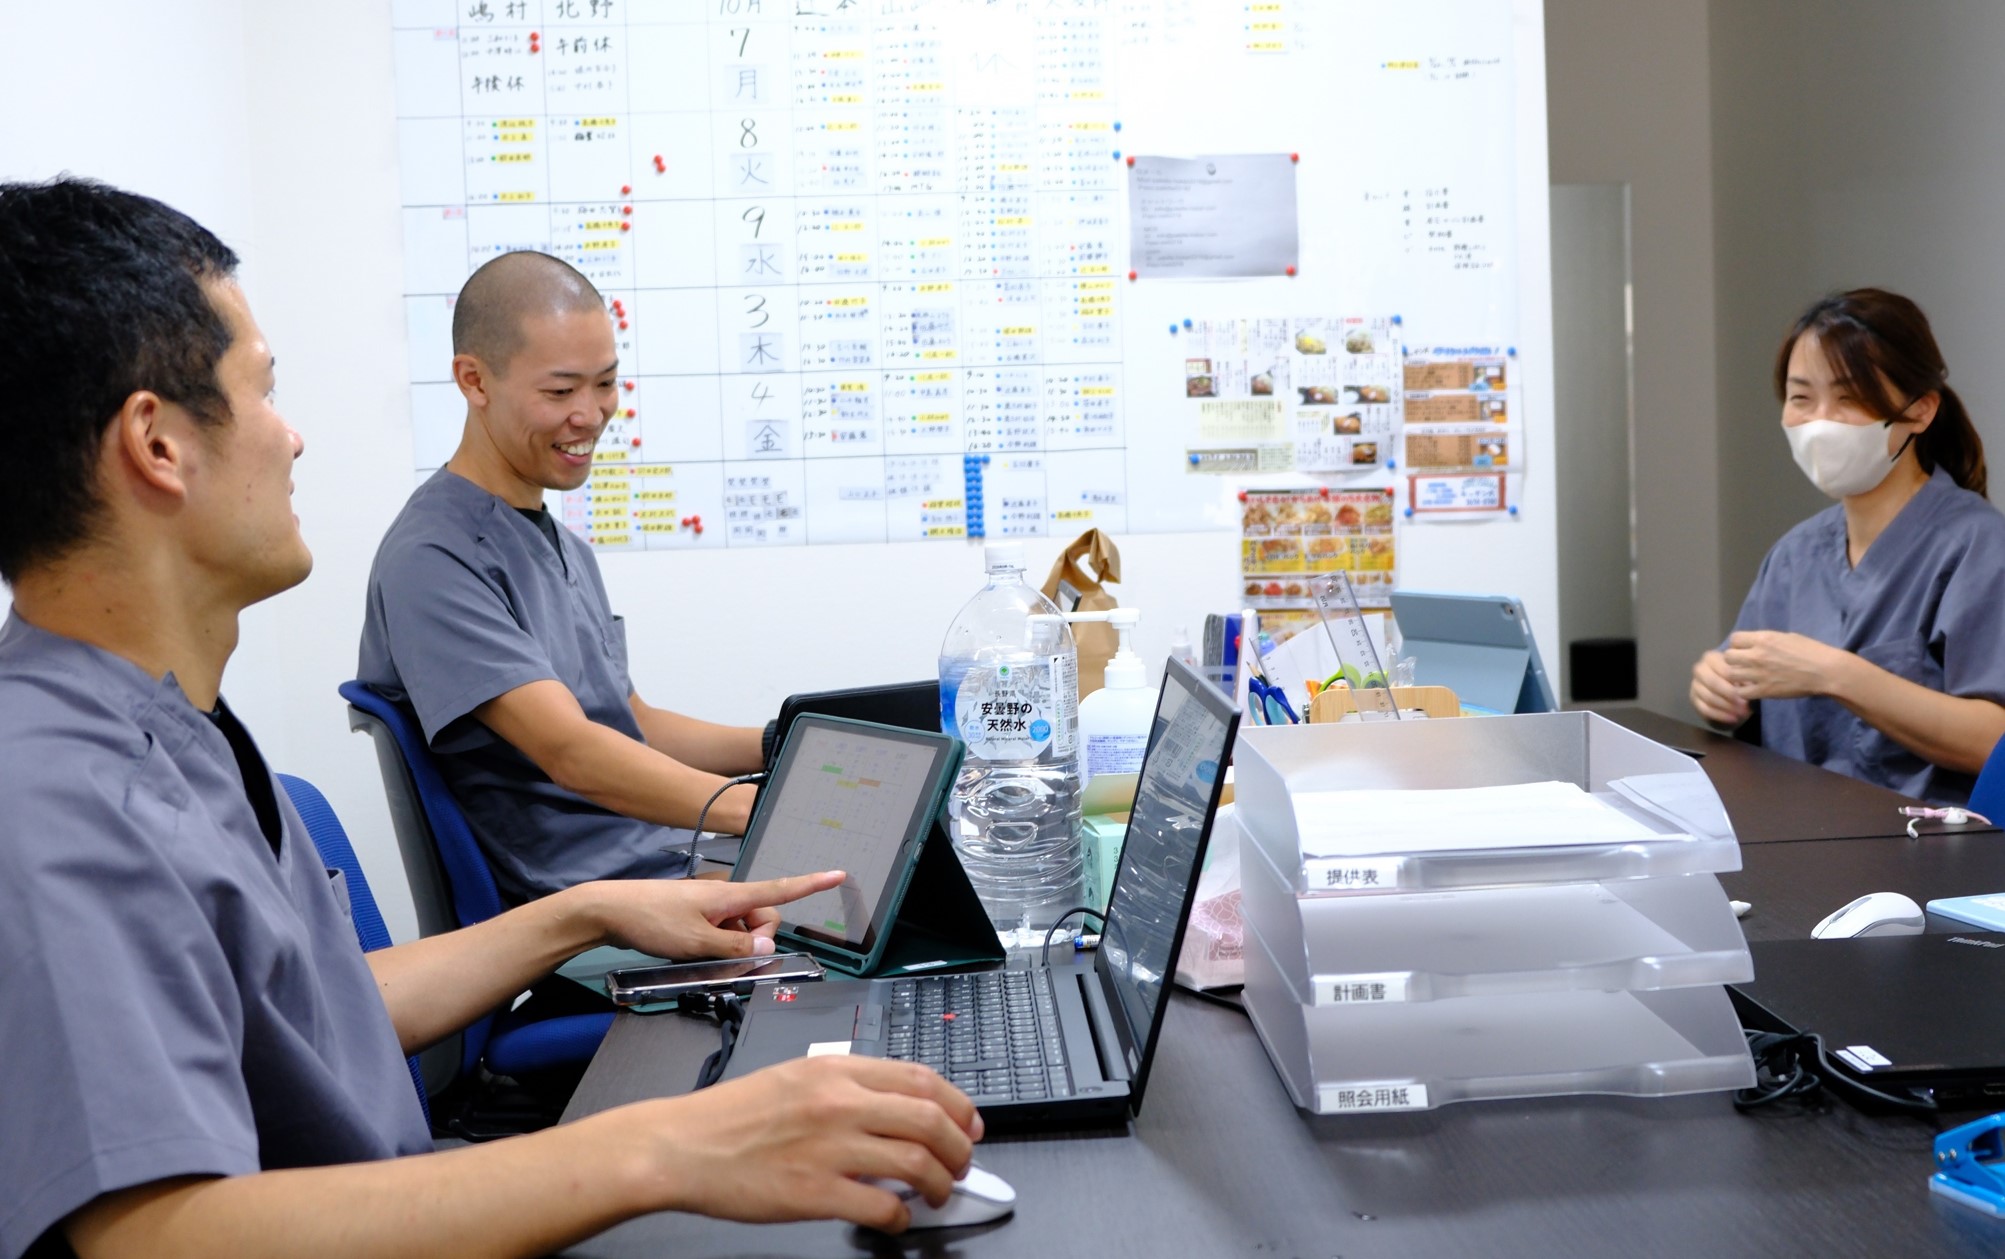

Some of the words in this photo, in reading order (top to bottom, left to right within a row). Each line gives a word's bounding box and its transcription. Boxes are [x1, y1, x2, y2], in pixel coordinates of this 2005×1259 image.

[556, 0, 614, 19] 北野
[556, 36, 613, 56] 午前休
[730, 28, 750, 57] 7
[471, 74, 525, 95] 午後休
[736, 69, 757, 99] 月
[740, 118, 758, 149] 8
[740, 158, 769, 185] 火
[742, 205, 765, 239] 9
[745, 247, 782, 275] 水
[744, 294, 769, 328] 3
[747, 336, 780, 365] 木
[751, 381, 776, 412] 4
[753, 425, 783, 453] 金
[981, 702, 1033, 716] 安曇野の
[987, 718, 1027, 732] 天然水
[1326, 868, 1379, 886] 提供表
[1333, 983, 1387, 1002] 計画書
[1338, 1087, 1410, 1109] 照会用紙
